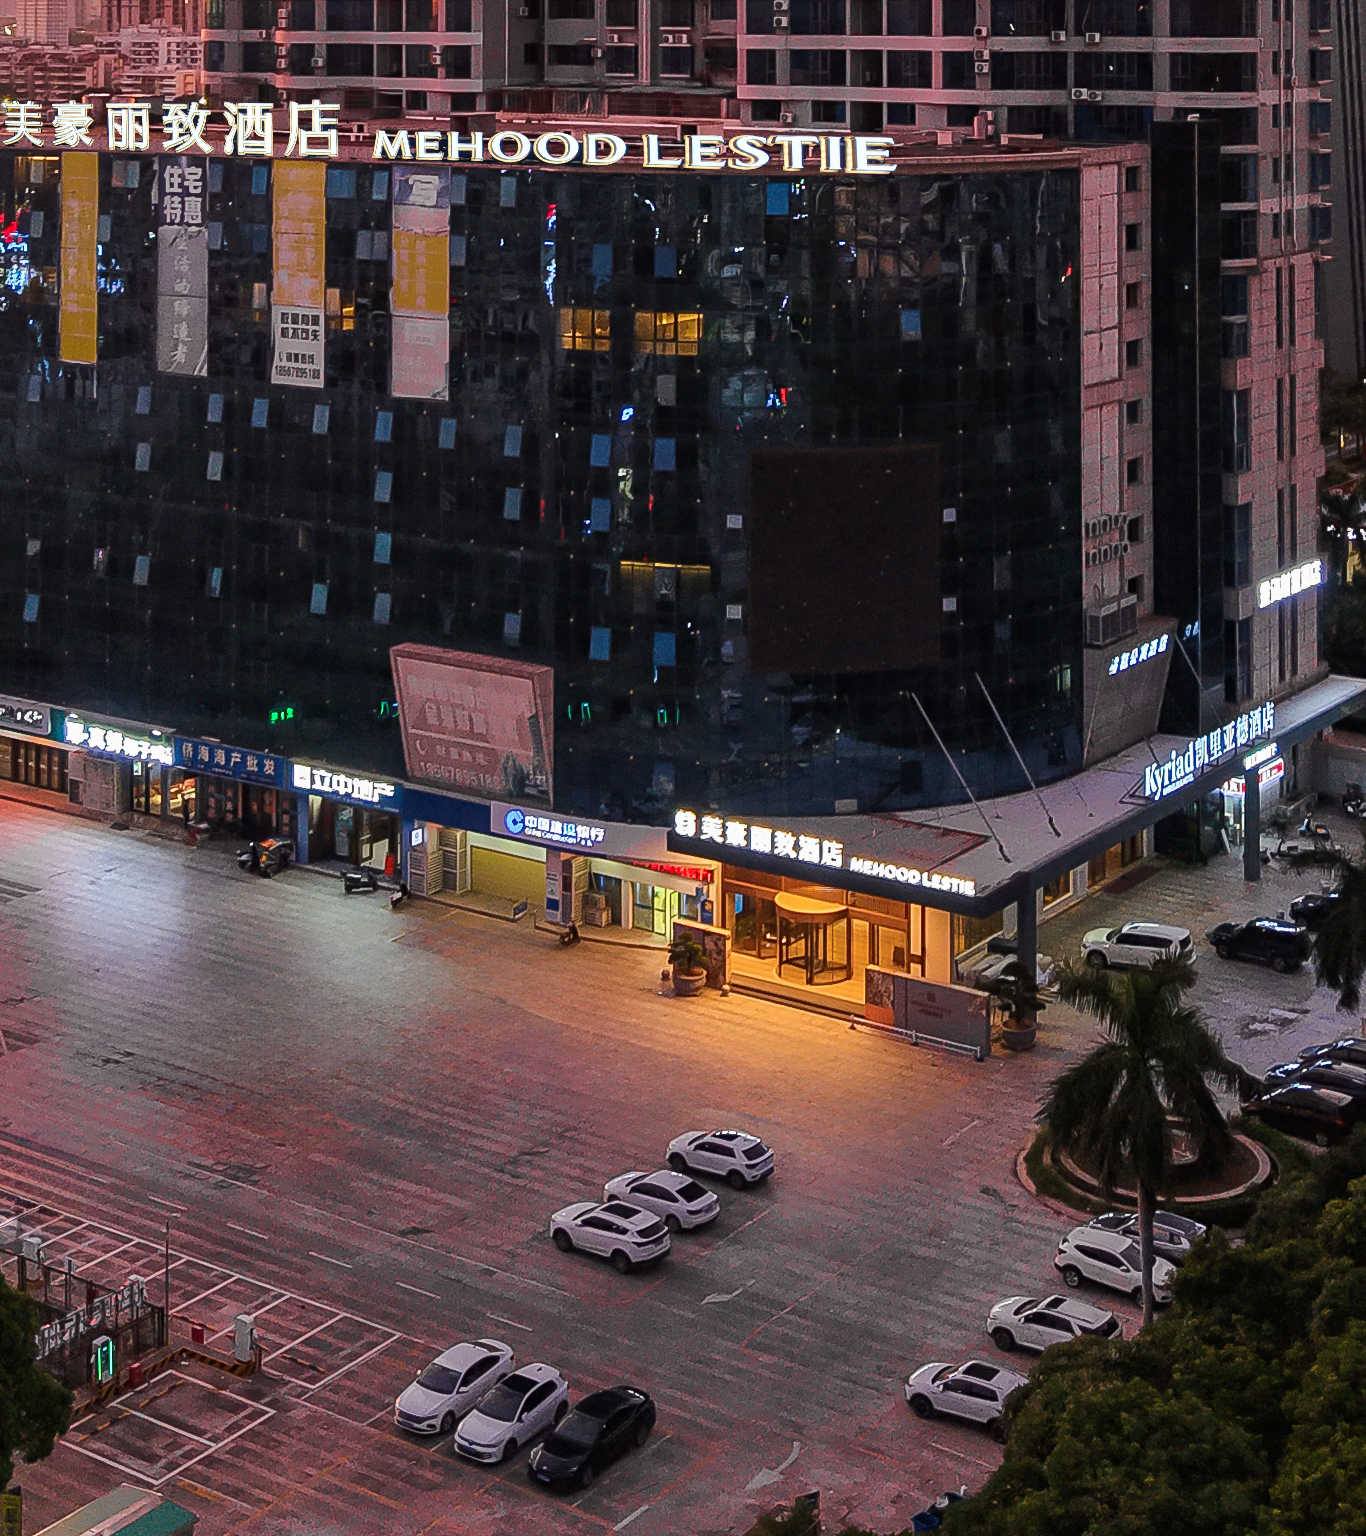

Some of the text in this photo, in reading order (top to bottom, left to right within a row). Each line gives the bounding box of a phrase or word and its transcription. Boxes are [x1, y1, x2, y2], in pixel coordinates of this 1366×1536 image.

[2, 99, 341, 158] 美豪丽致酒店
[372, 129, 898, 175] MEHOOD LESTIE
[164, 165, 203, 193] 住宅
[163, 195, 203, 224] 特惠
[1144, 740, 1195, 801] Kyriad
[1194, 701, 1275, 769] 凯里亚德酒店
[312, 769, 395, 803] 立中地产
[524, 815, 605, 842] 中国建设银行
[699, 814, 845, 868] 美豪丽致酒店
[849, 856, 977, 897] MEHOOD LESTIE
